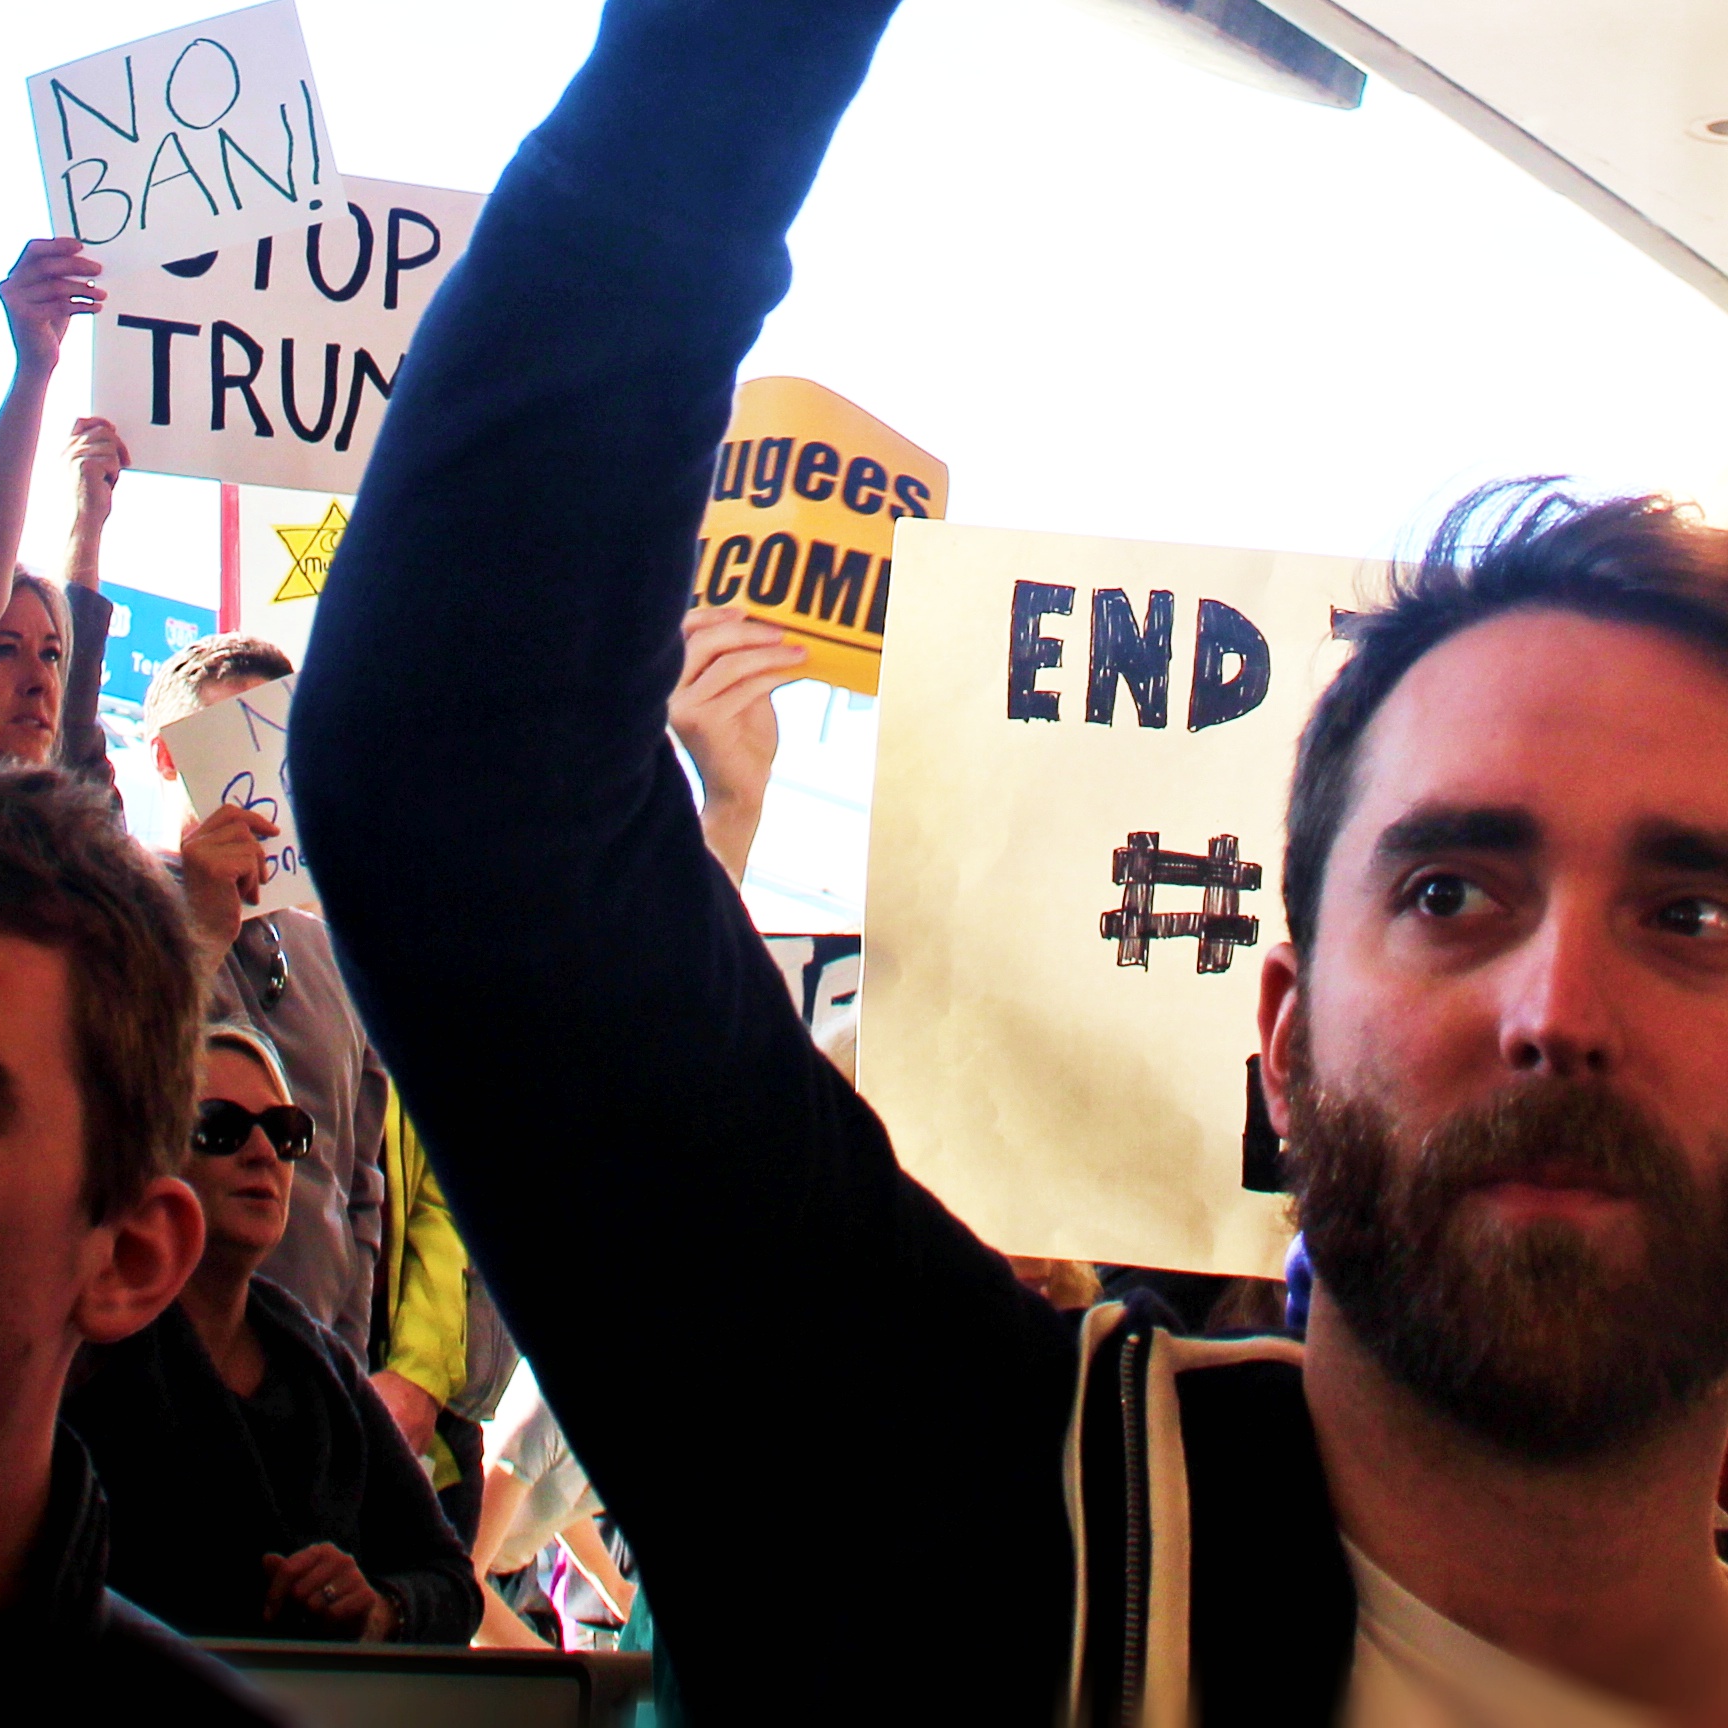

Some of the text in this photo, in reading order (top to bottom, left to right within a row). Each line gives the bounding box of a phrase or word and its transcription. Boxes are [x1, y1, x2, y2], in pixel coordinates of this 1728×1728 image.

[50, 37, 241, 160] NO
[60, 78, 324, 245] BAN!
[1006, 579, 1272, 733] END
